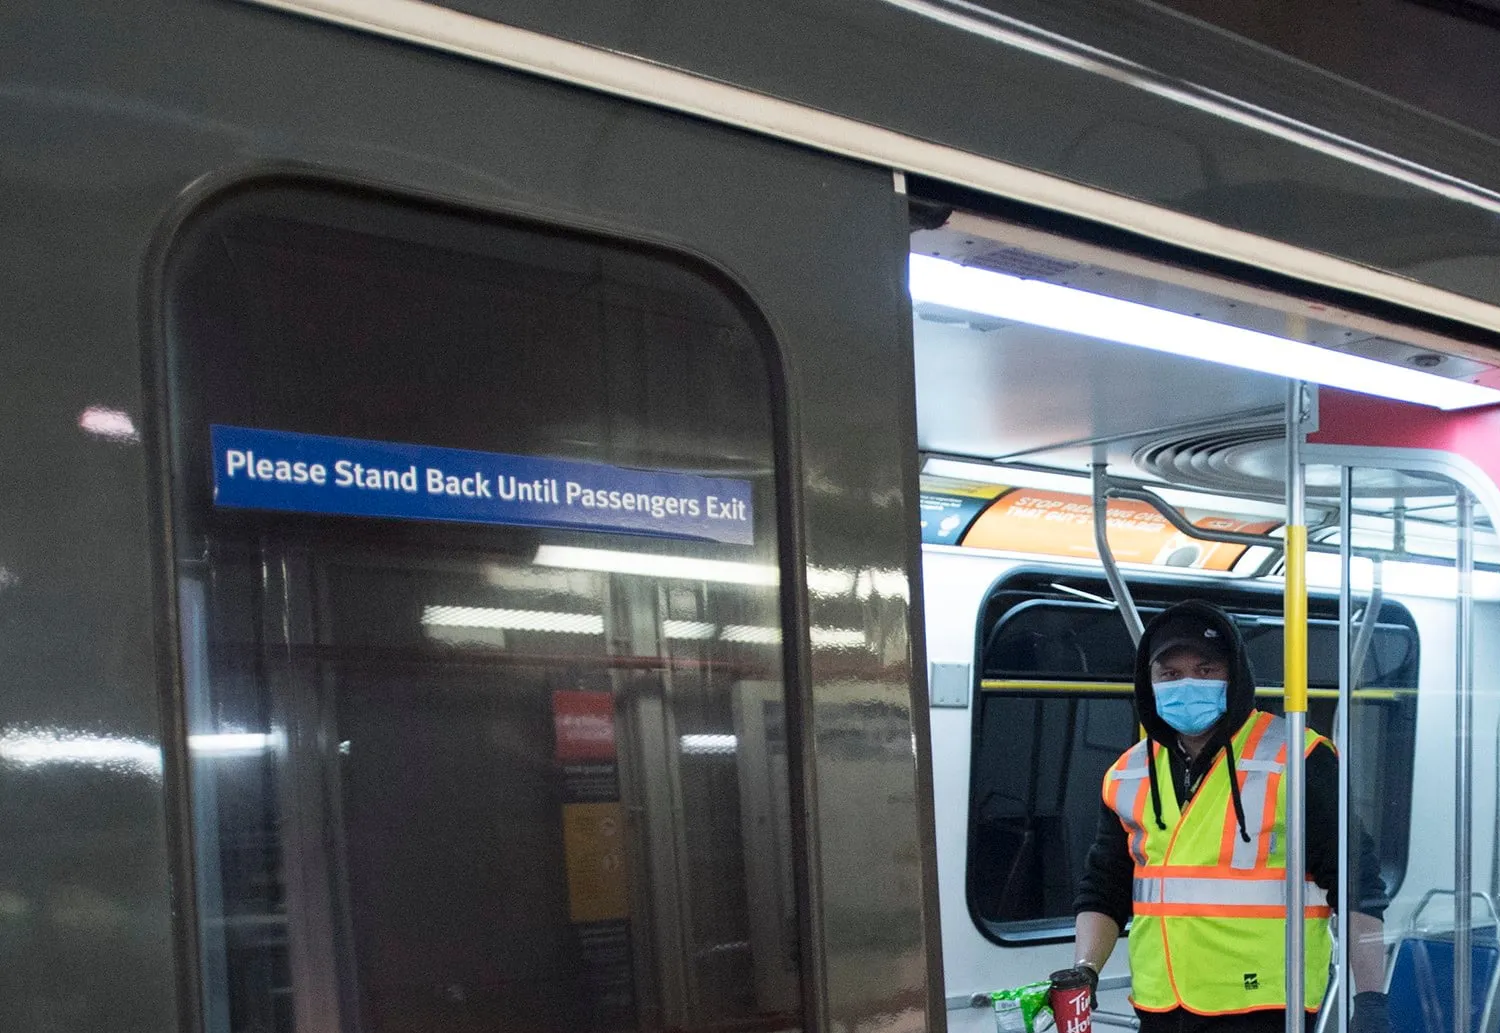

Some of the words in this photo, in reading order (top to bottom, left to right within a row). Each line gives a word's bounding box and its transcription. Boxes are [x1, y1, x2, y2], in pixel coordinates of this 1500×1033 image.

[226, 449, 326, 485] Please
[334, 459, 417, 492] Stand
[426, 468, 492, 498] Back
[498, 475, 558, 504] Until
[566, 481, 700, 519] Passengers
[707, 495, 746, 522] Exit
